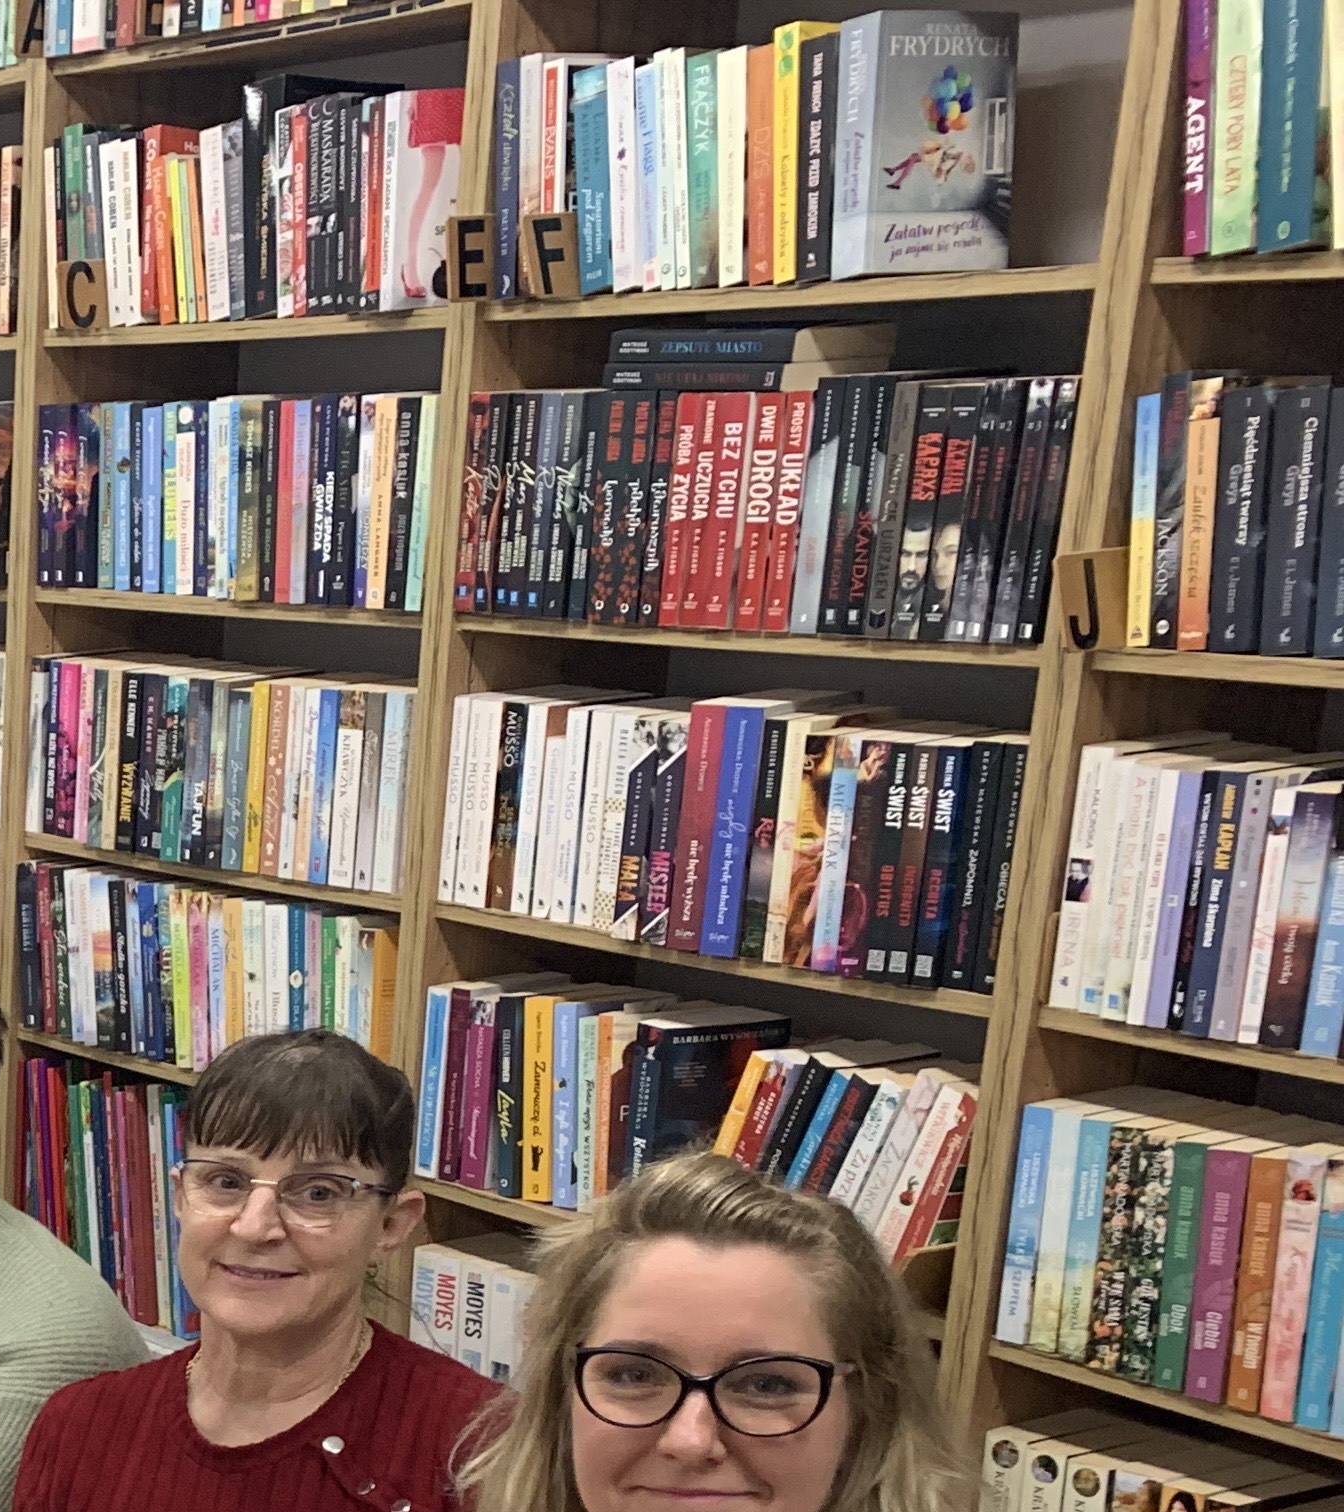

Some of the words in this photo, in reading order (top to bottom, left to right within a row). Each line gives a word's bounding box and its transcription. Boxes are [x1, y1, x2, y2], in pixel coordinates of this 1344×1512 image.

[888, 35, 1011, 57] FRYDRYCH
[544, 125, 557, 179] EVANS
[1184, 96, 1205, 193] AGENT
[457, 219, 487, 298] E
[532, 217, 565, 294] F
[884, 223, 934, 244] Załatw
[67, 261, 97, 328] C
[399, 412, 413, 447] anna
[676, 425, 695, 466] PRÓBA
[721, 421, 743, 460] BEZ
[758, 405, 776, 443] DWIE
[788, 401, 806, 448] PROSTY
[670, 473, 692, 523] ŻYCIA
[691, 450, 714, 521] UCZUCIA
[715, 468, 738, 519] TCHU
[746, 449, 777, 523] DROGI
[775, 453, 804, 526] UKŁAD
[313, 483, 325, 552] GWIAZDA
[1235, 500, 1252, 546] twarzy
[1293, 504, 1309, 549] strona
[849, 511, 873, 600] SKANDAL
[1155, 517, 1173, 597] JACKSON
[1069, 558, 1099, 650] J
[503, 710, 518, 767] MUSSO
[119, 761, 135, 822] WYZWANIE
[191, 781, 204, 836] TAJFUN
[585, 792, 600, 844] MUSSO
[884, 784, 908, 830] ŚWIST
[906, 784, 930, 830] ŚWIST
[933, 788, 955, 833] ŚWIST
[1213, 823, 1235, 870] KAPLAN
[1058, 911, 1081, 969] IRENA
[495, 1088, 515, 1145] Layla
[434, 1273, 456, 1331] MOYES
[464, 1281, 485, 1340] MOYES
